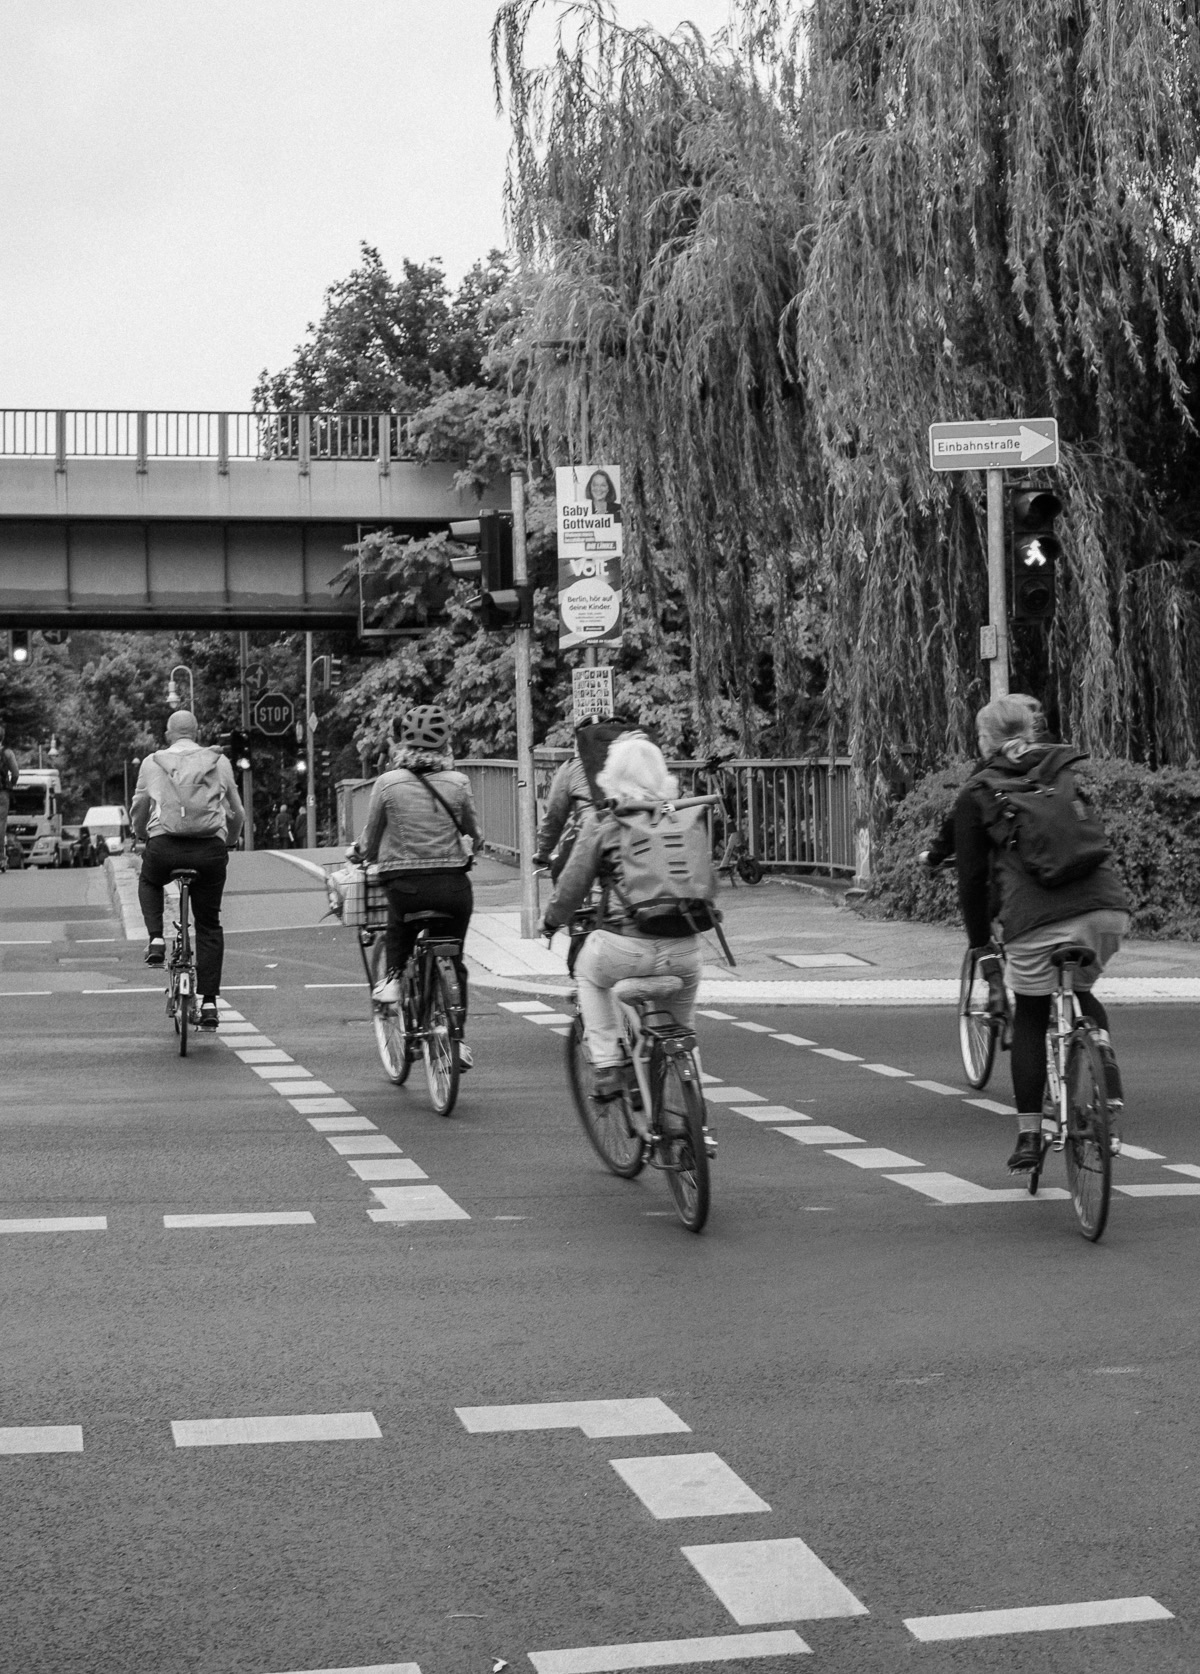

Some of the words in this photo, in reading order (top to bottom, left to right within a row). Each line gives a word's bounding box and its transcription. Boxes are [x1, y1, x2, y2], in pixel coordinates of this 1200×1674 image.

[938, 439, 1020, 452] Einbahnstraße
[562, 505, 589, 517] Gaby
[563, 517, 611, 529] Gottwald
[567, 595, 588, 603] Berlin,
[589, 594, 601, 602] hör
[602, 594, 613, 602] auf
[260, 706, 289, 722] STOP
